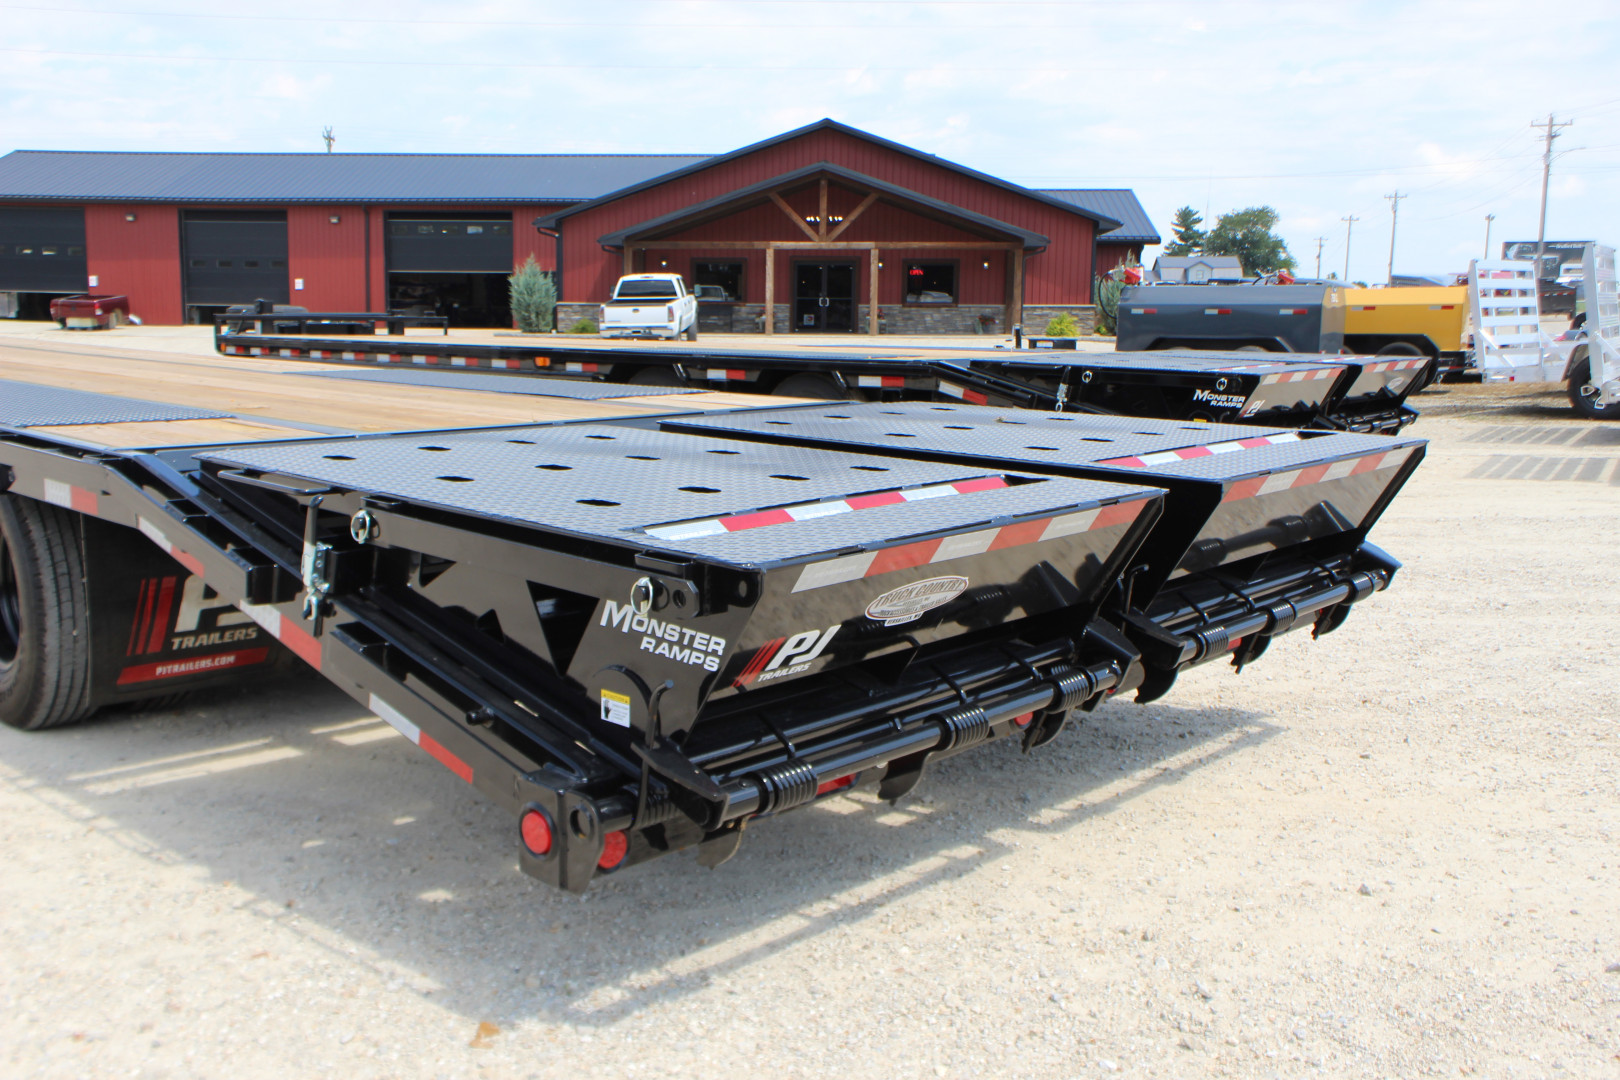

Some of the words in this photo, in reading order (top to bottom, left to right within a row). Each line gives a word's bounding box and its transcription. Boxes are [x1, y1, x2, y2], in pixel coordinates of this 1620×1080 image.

[1193, 389, 1246, 402] MONSTER
[874, 586, 918, 609] TRUCK
[915, 579, 964, 597] COUNTRY
[171, 627, 257, 650] TRAILERS
[600, 599, 727, 656] MONSTER
[640, 636, 720, 672] RAMPS
[764, 624, 842, 672] PJ
[155, 655, 236, 676] PJTRAILERS.COM
[757, 662, 812, 682] TRAILERS
